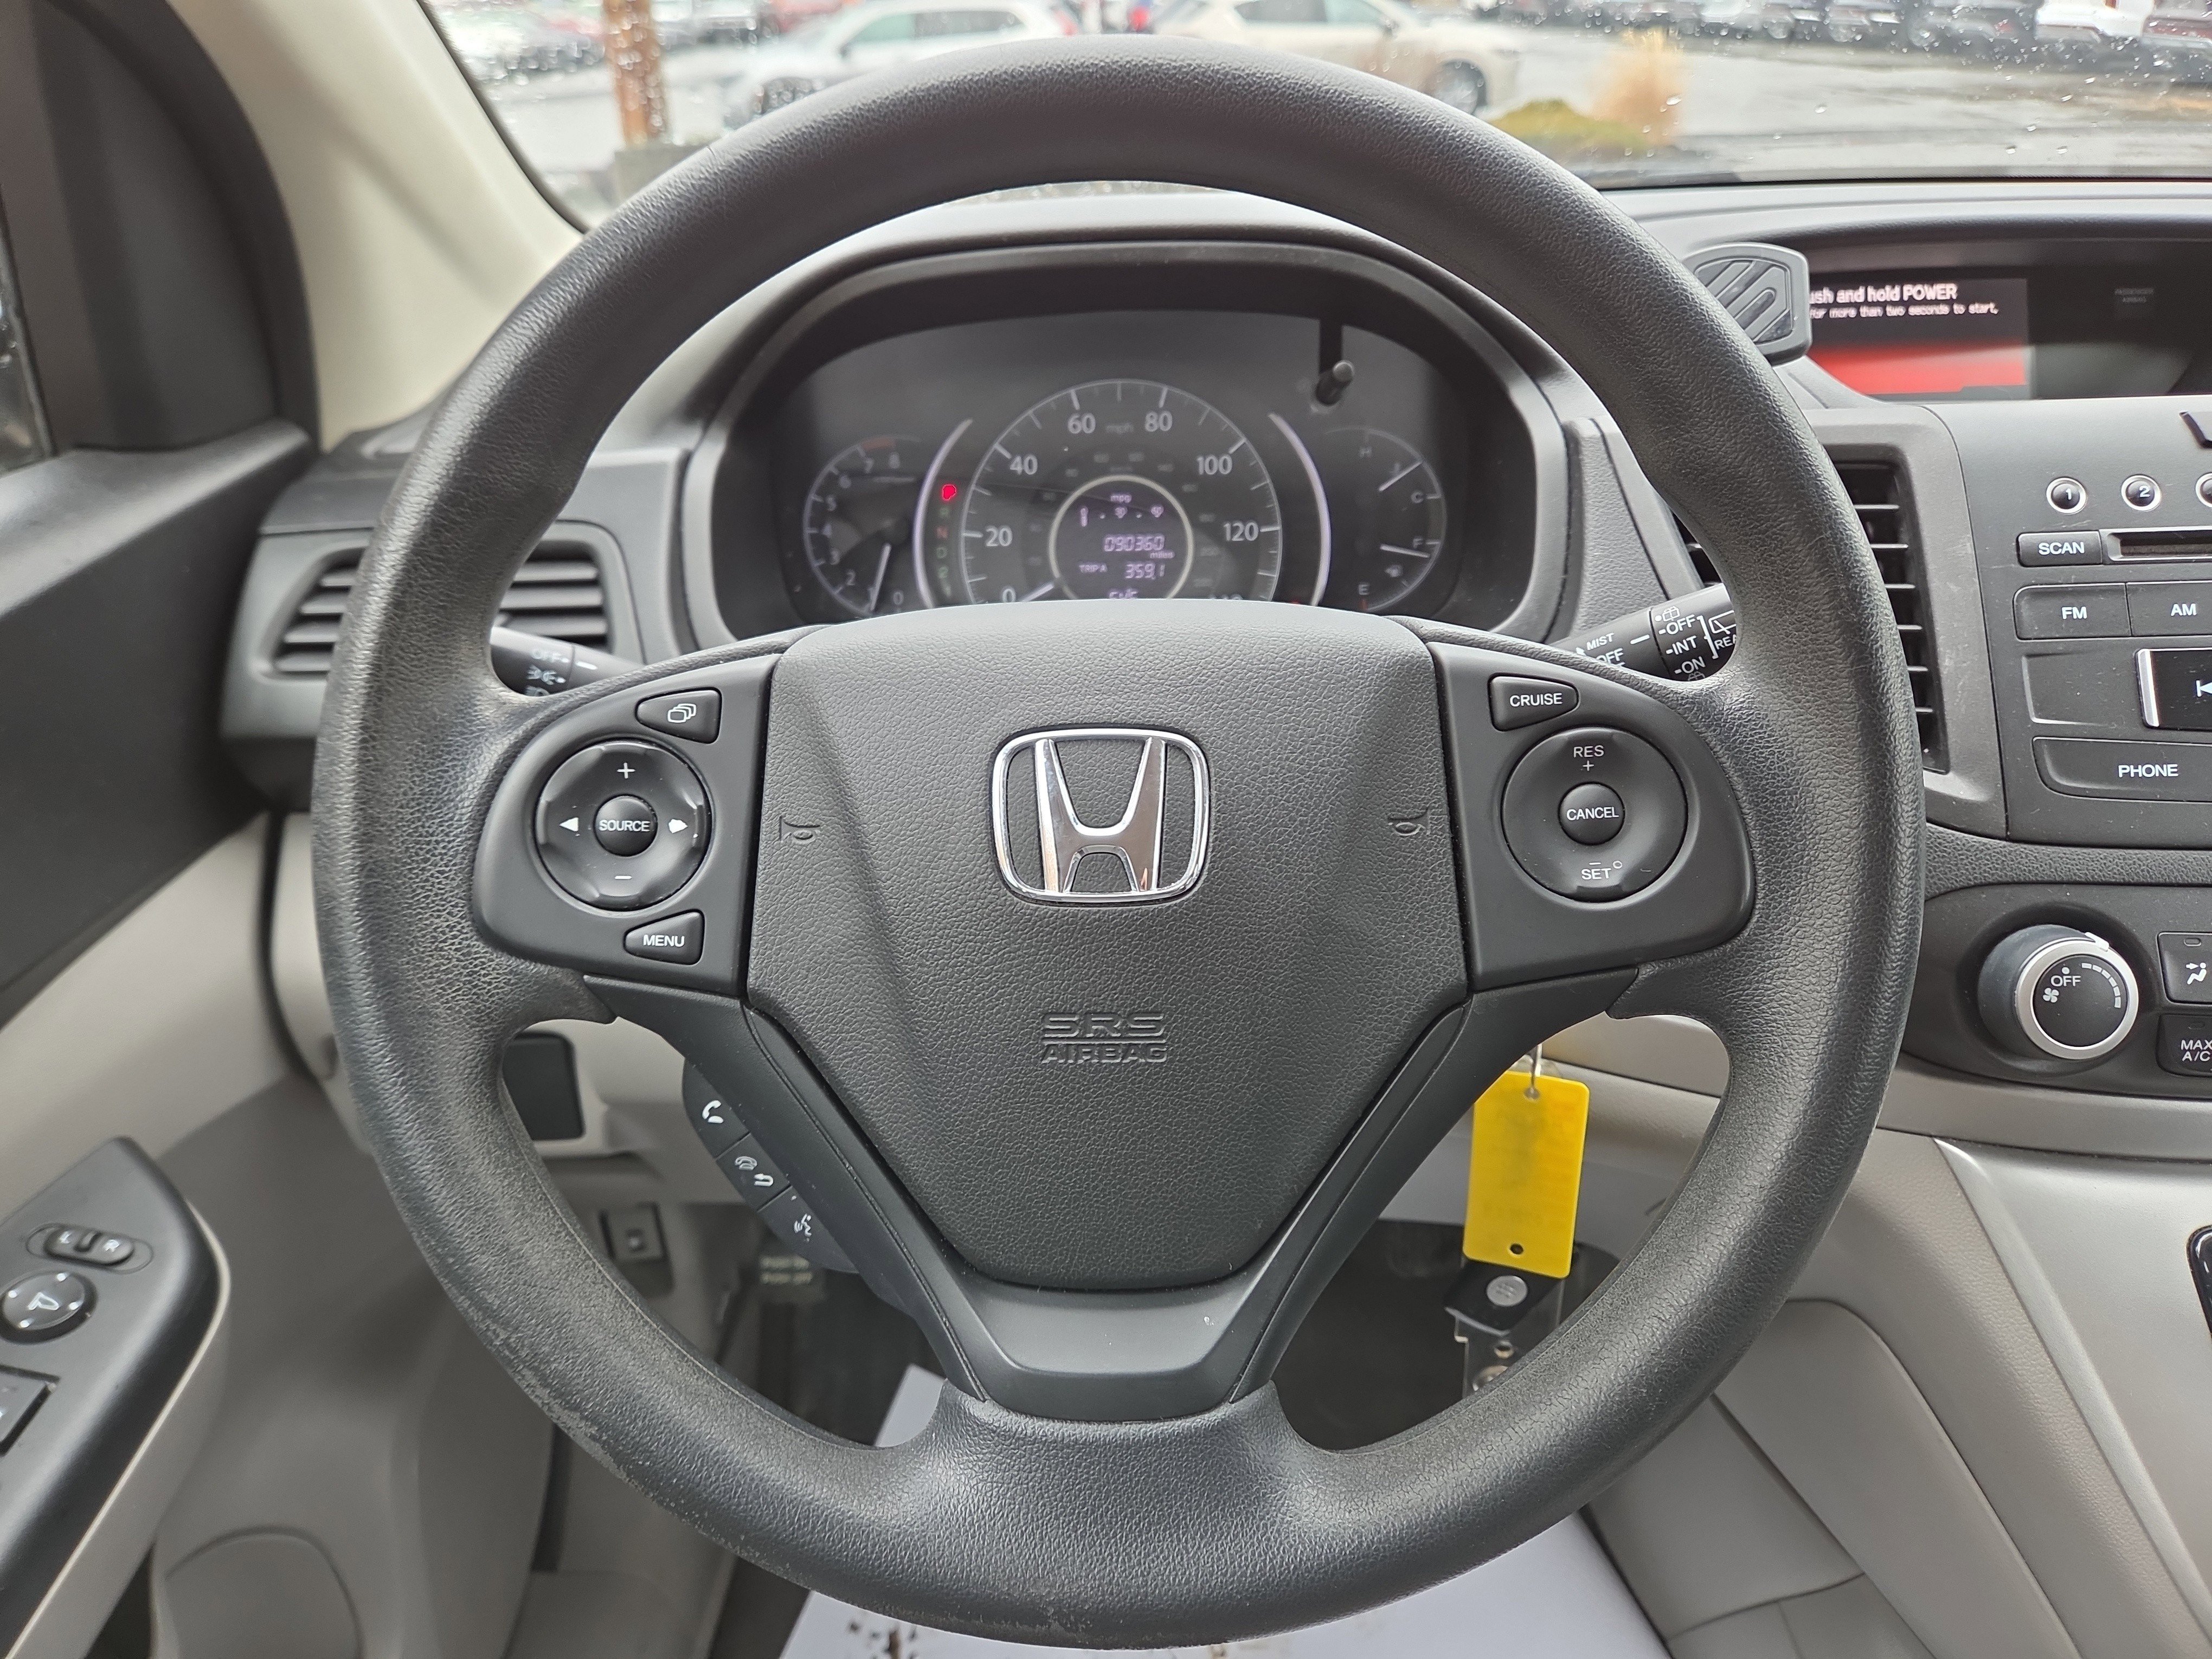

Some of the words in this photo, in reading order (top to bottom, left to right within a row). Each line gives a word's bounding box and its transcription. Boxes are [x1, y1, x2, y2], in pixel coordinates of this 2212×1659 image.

[1836, 285, 1865, 304] and
[1867, 285, 1901, 302] hold
[1902, 283, 1958, 301] POWER
[1829, 307, 1857, 318] more
[1859, 305, 1883, 317] than
[1886, 304, 1906, 316] two
[1908, 303, 1950, 316] seconds
[1953, 303, 1966, 314] to
[1068, 413, 1096, 434] 60
[1145, 411, 1173, 432] 80
[1010, 454, 1038, 476] 40
[1197, 454, 1232, 476] 100
[2065, 487, 2072, 500] 1
[2139, 485, 2151, 498] 2
[985, 526, 1013, 547] 20
[1223, 521, 1259, 542] 120
[2038, 542, 2085, 555] SCAN
[2062, 607, 2087, 620] FM
[2171, 603, 2197, 616] AM
[1666, 614, 1696, 635] OFF
[1586, 633, 1615, 650] MIST
[1671, 635, 1697, 655] INT
[1681, 656, 1706, 673] ON
[1509, 693, 1563, 708] CRUISE
[1573, 745, 1604, 758] RES
[2118, 764, 2179, 778] PHONE
[1566, 806, 1619, 821] CANCEL
[599, 819, 651, 833] SOURCE
[1581, 868, 1612, 880] SET
[643, 934, 685, 948] MENU
[2051, 975, 2081, 987] OFF
[1043, 1013, 1165, 1038] SRS
[2181, 1039, 2212, 1050] MAX
[1041, 1045, 1168, 1064] AIRBAG
[2182, 1051, 2211, 1062] A/C
